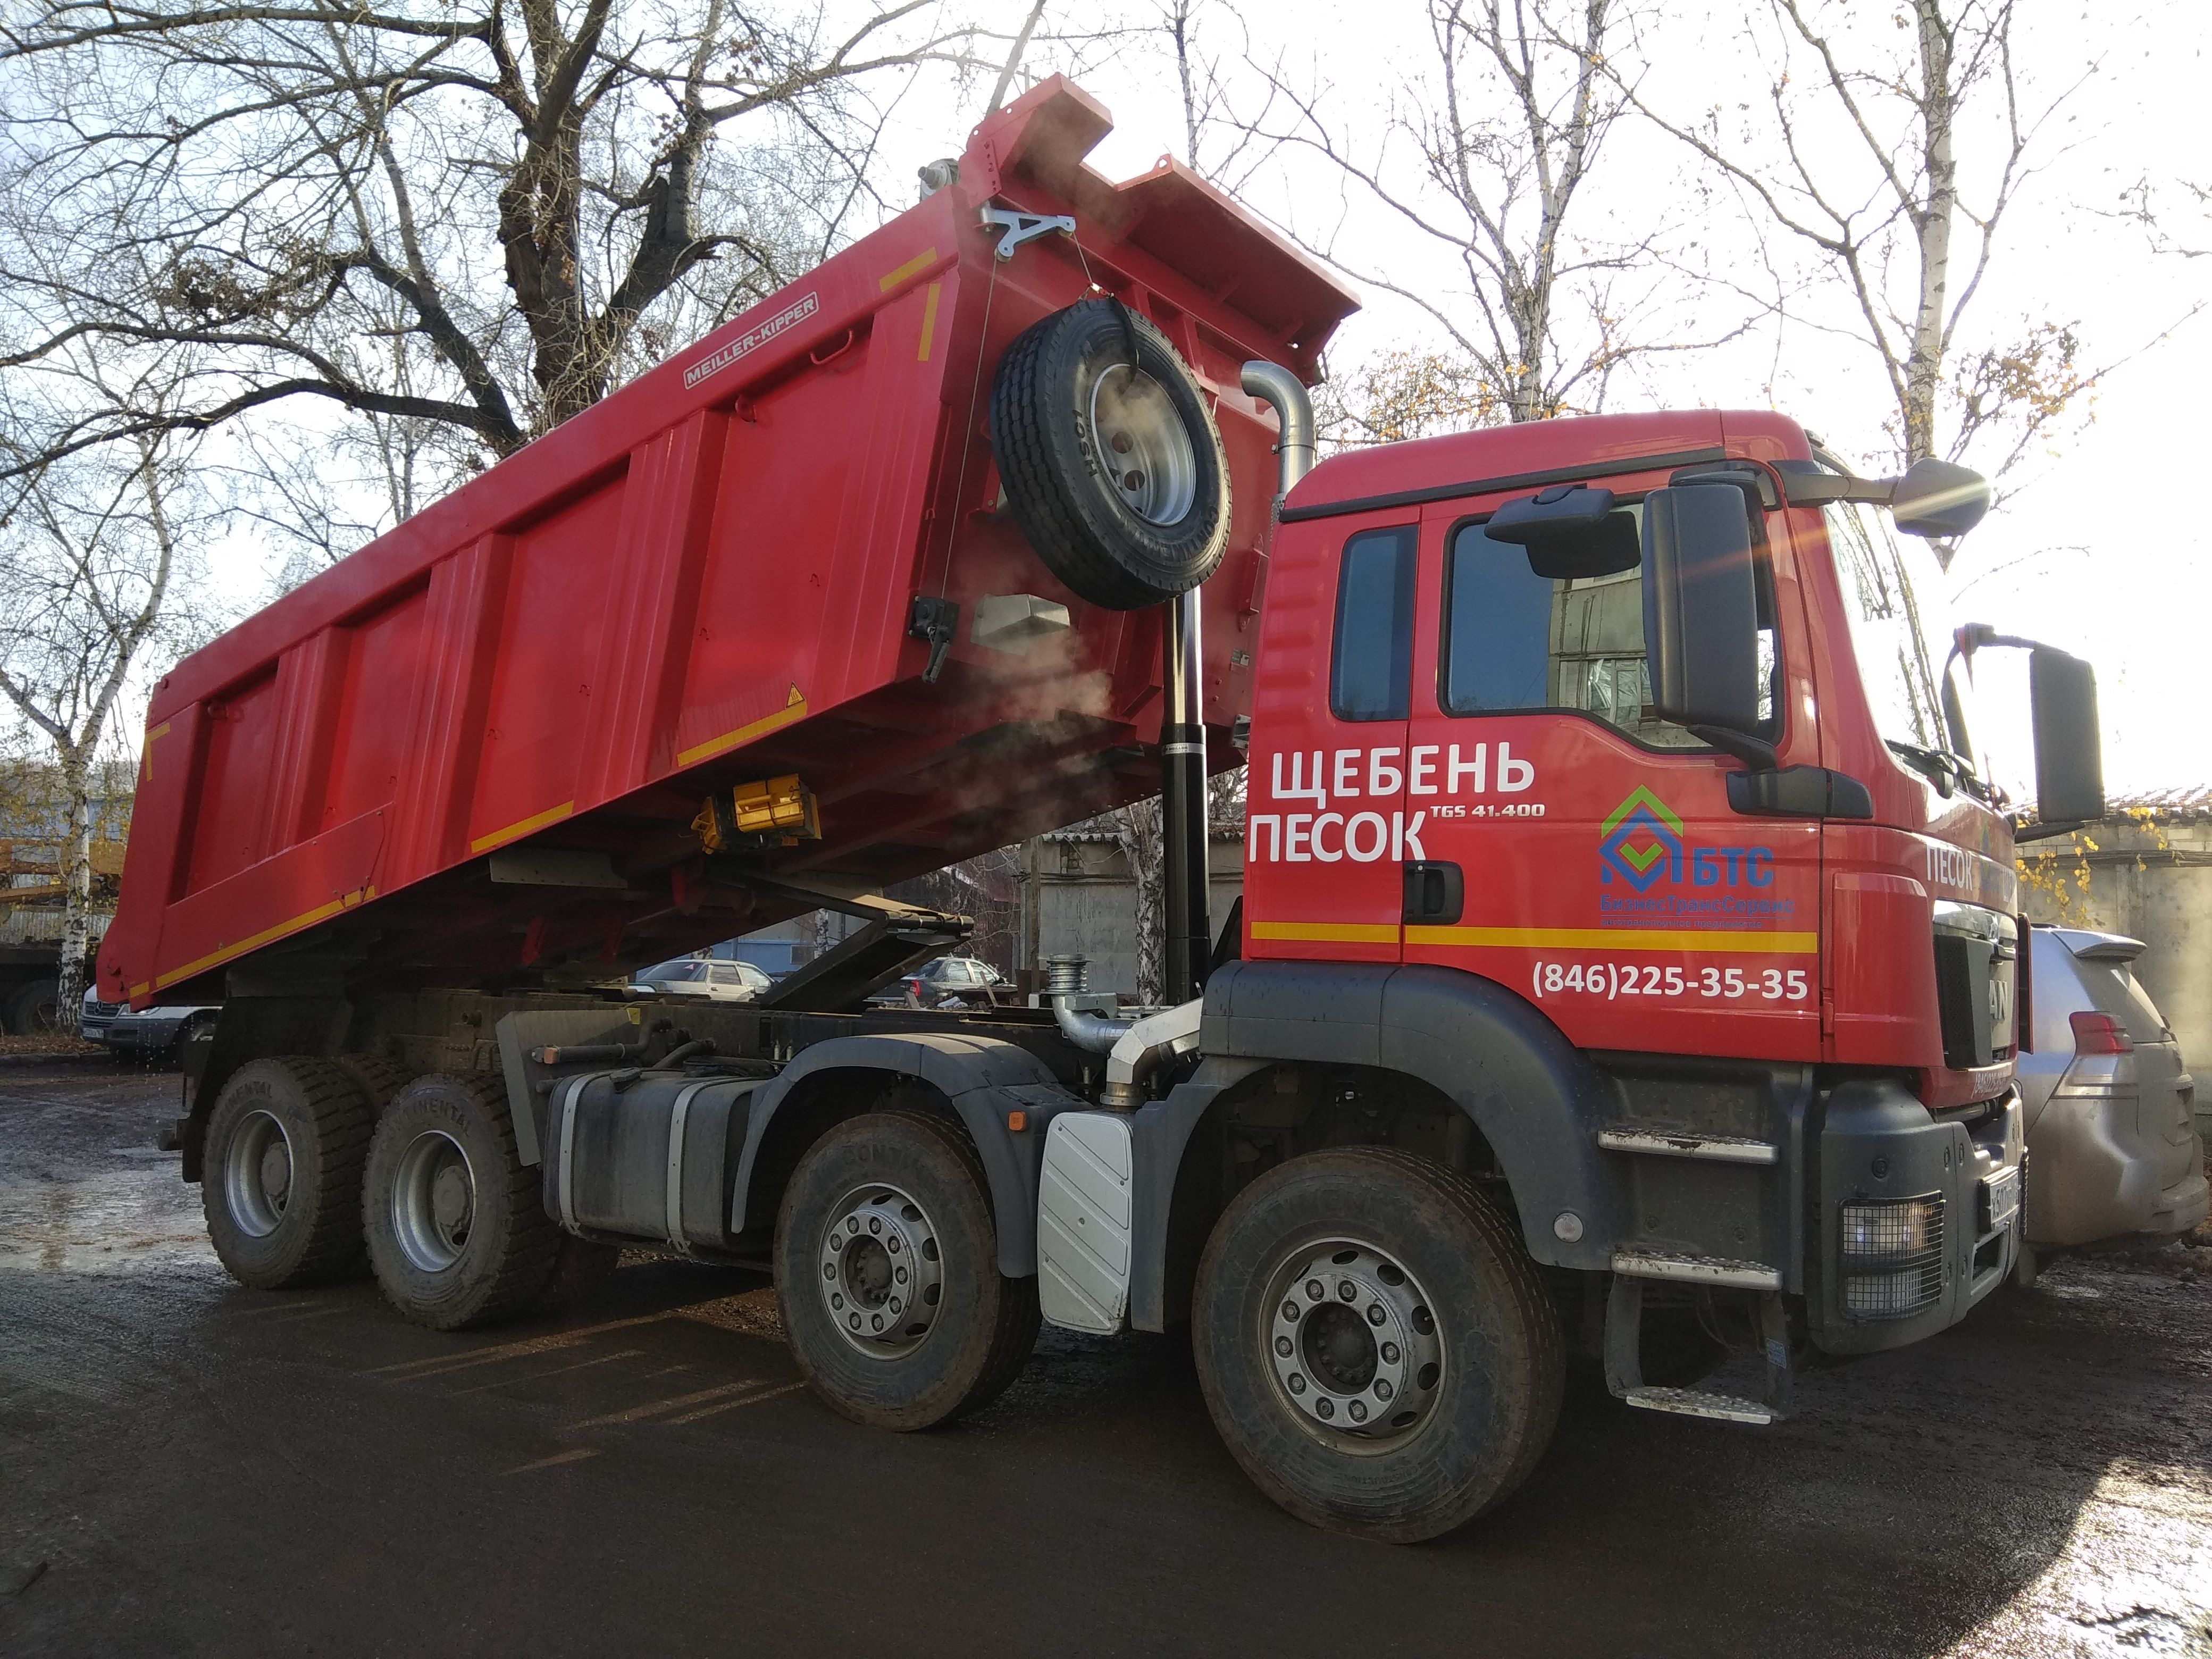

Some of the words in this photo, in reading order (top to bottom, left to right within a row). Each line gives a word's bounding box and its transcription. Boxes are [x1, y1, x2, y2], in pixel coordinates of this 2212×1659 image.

[686, 298, 815, 384] MEILLER-KIPPER
[1271, 742, 1535, 809] ЩЕБЕНЬ
[1430, 805, 1466, 818] TGS
[1471, 803, 1545, 818] 41.400
[1249, 810, 1427, 862] ПЕСОК
[1692, 846, 1774, 887] БТС
[1926, 843, 1973, 891] ПЕСОК
[1600, 894, 1795, 917] БизнесТрансСервис
[1533, 961, 1808, 1000] (846)225-35-35
[1989, 979, 2008, 1021] AN
